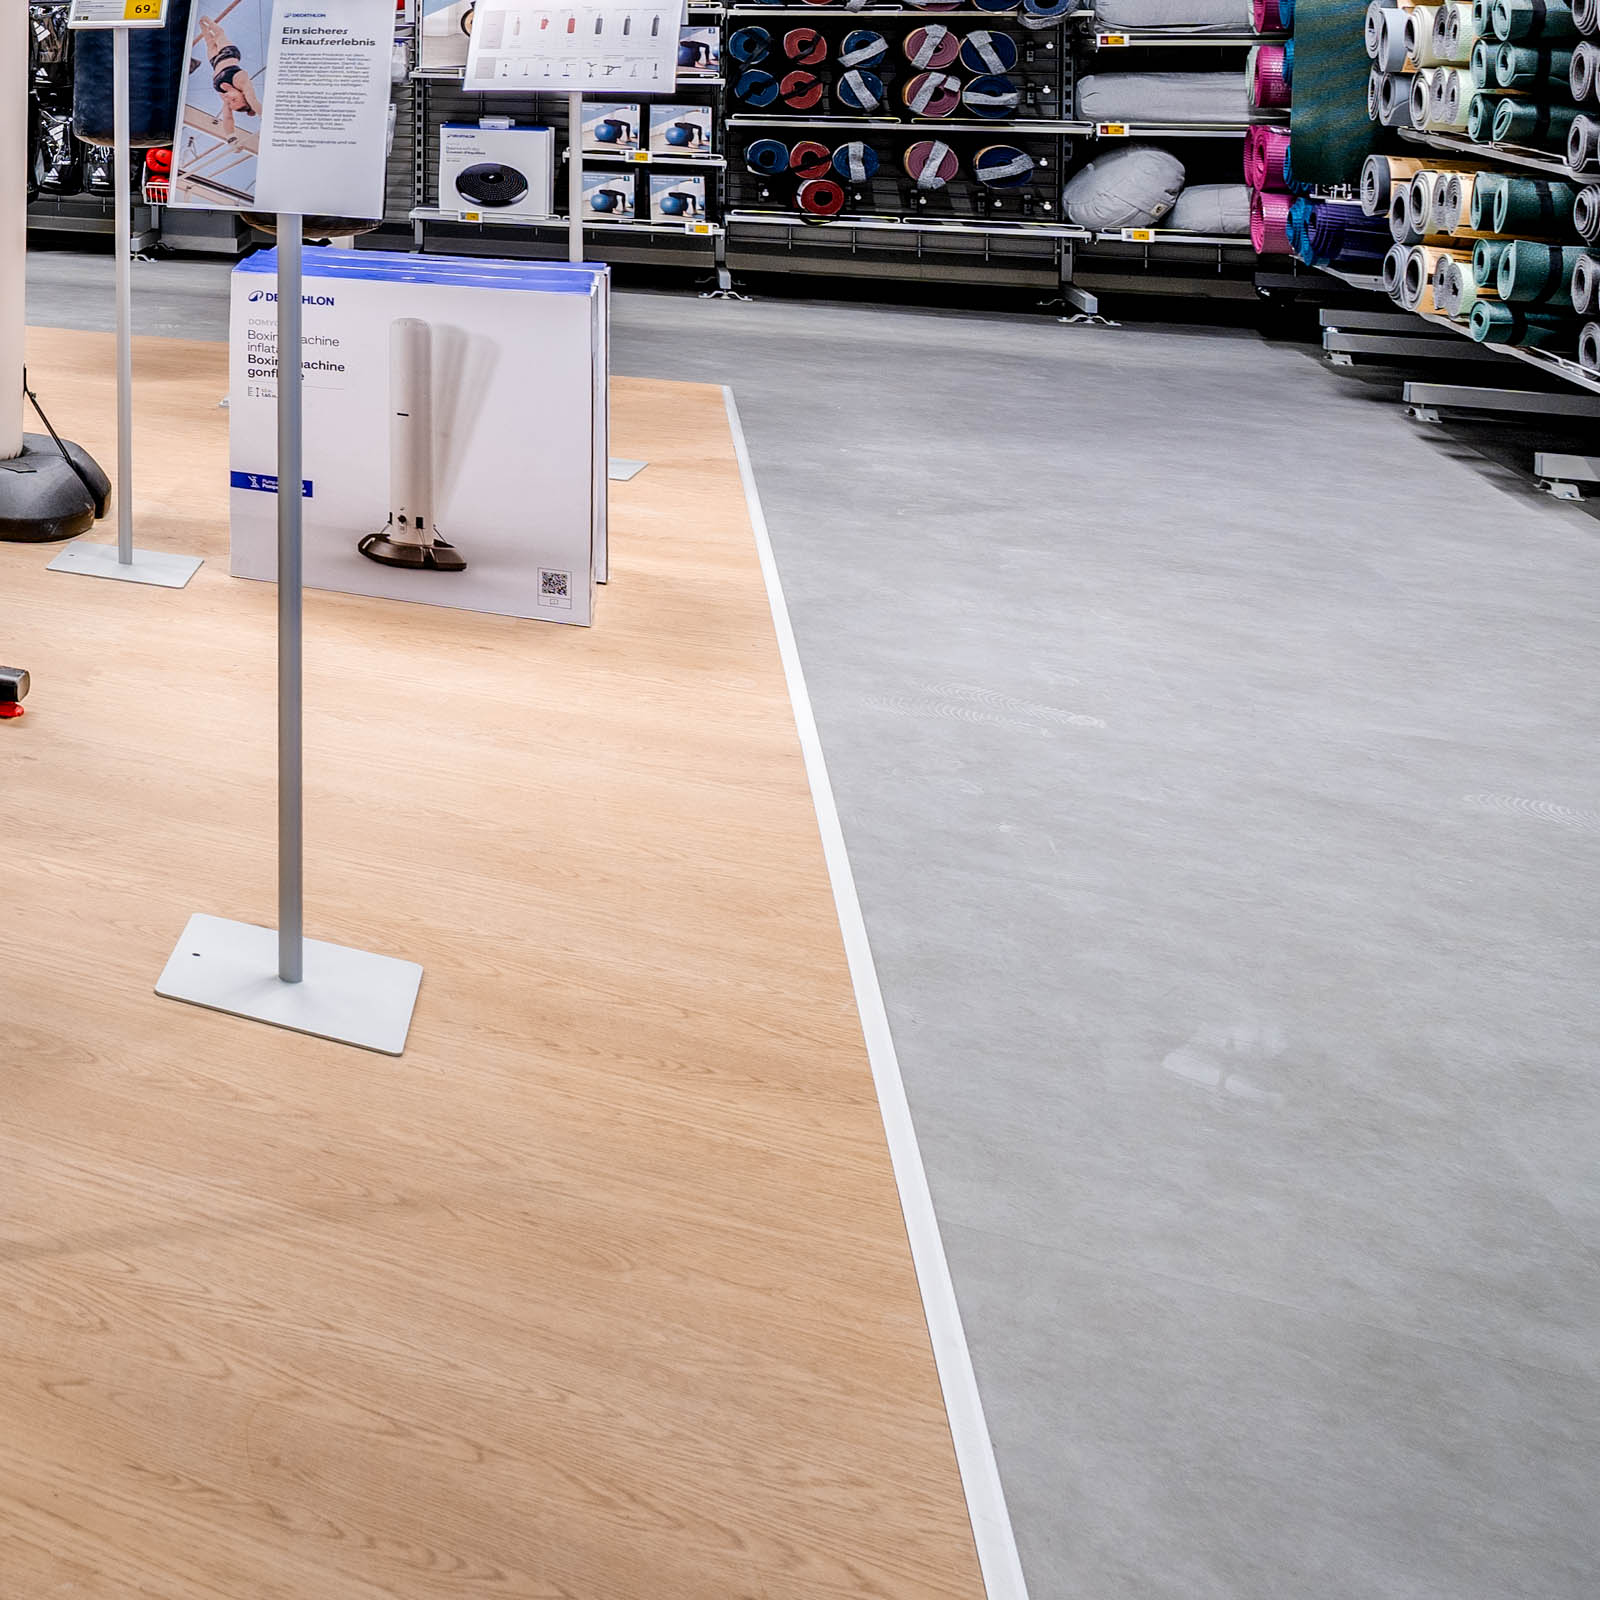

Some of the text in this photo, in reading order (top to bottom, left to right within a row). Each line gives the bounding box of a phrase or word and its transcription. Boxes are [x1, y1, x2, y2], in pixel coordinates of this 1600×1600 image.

[135, 4, 150, 13] 69
[282, 26, 348, 35] Ein sicheres
[281, 37, 376, 47] Einkaufserlebnis
[265, 292, 335, 306] DEHLON
[248, 318, 279, 326] DOMYO
[248, 329, 340, 347] Boxin achine
[248, 354, 345, 372] Boxin achine
